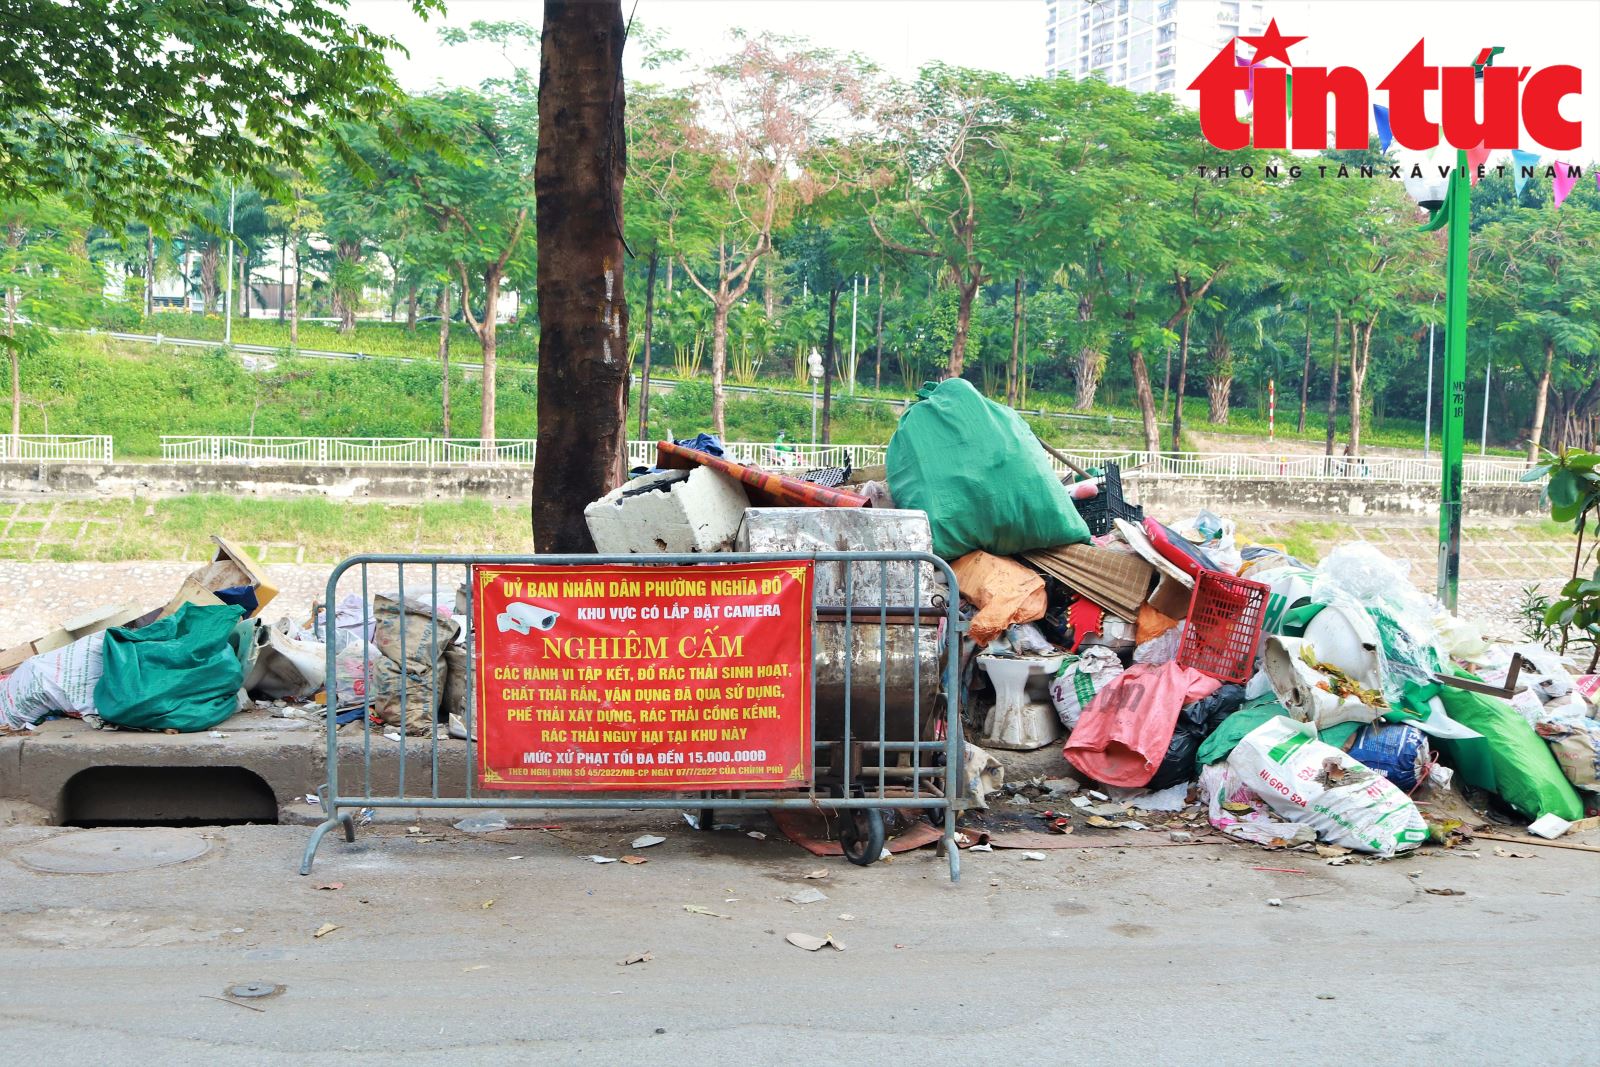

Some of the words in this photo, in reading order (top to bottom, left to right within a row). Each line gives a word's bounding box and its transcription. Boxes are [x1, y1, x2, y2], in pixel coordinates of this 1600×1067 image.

[504, 577, 523, 598] UỶ
[528, 581, 560, 598] BAN
[563, 579, 605, 598] NHÂN
[610, 579, 640, 598] DÂN
[645, 577, 707, 597] PHƯỜNG
[711, 577, 758, 596] NGHĨA
[761, 576, 782, 595] ĐÔ
[577, 607, 606, 620] KHU
[610, 606, 637, 622] VỰC
[641, 605, 659, 619] CÓ
[664, 602, 690, 619] LẮP
[694, 604, 720, 621] ĐẶT
[724, 604, 781, 618] CAMERA
[541, 630, 669, 659] NGHIÊM
[678, 625, 745, 659] CẤM
[494, 665, 520, 681] CÁC
[524, 665, 559, 681] HÀNH
[562, 668, 574, 681] VI
[577, 666, 602, 683] TẬP
[607, 664, 634, 682] KẾT,
[637, 663, 655, 680] ĐỔ
[659, 665, 685, 680] RÁC
[689, 663, 718, 680] THẢI
[722, 666, 754, 679] SINH
[757, 664, 792, 679] HOẠT,
[502, 684, 535, 701] CHẤT
[539, 685, 567, 701] THẢI
[571, 685, 601, 702] RẮN,
[605, 687, 631, 704] VẬN
[635, 689, 670, 704] DỤNG
[674, 686, 692, 701] ĐÃ
[696, 688, 721, 702] QUA
[725, 683, 744, 699] SỬ
[747, 685, 785, 701] DỤNG,
[507, 706, 533, 722] PHẾ
[536, 706, 565, 722] THẢI
[568, 707, 593, 722] XÂY
[597, 709, 636, 724] DỰNG,
[640, 708, 666, 722] RÁC
[670, 706, 699, 722] THẢI
[541, 727, 567, 742] RÁC
[571, 727, 599, 742] THẢI
[603, 730, 638, 743] NGUY
[641, 730, 663, 745] HẠI
[667, 730, 688, 745] TẠI
[691, 729, 718, 742] KHU
[721, 726, 748, 741] NÀY
[523, 750, 552, 764] MỨC
[556, 749, 574, 764] XỬ
[577, 753, 610, 766] PHẠT
[613, 749, 633, 764] TỐI
[636, 753, 654, 765] ĐA
[658, 749, 684, 764] ĐẾN
[508, 768, 528, 776] THEO
[531, 768, 550, 777] NGHỊ
[553, 768, 572, 777] ĐỊNH
[575, 766, 586, 776] SỐ
[651, 767, 673, 777] NGÀY
[676, 768, 717, 776] 07/7/2022
[719, 765, 736, 775] CỦA
[739, 765, 764, 774] CHÍNH
[766, 763, 784, 774] PHỦ
[1290, 793, 1308, 808] 524
